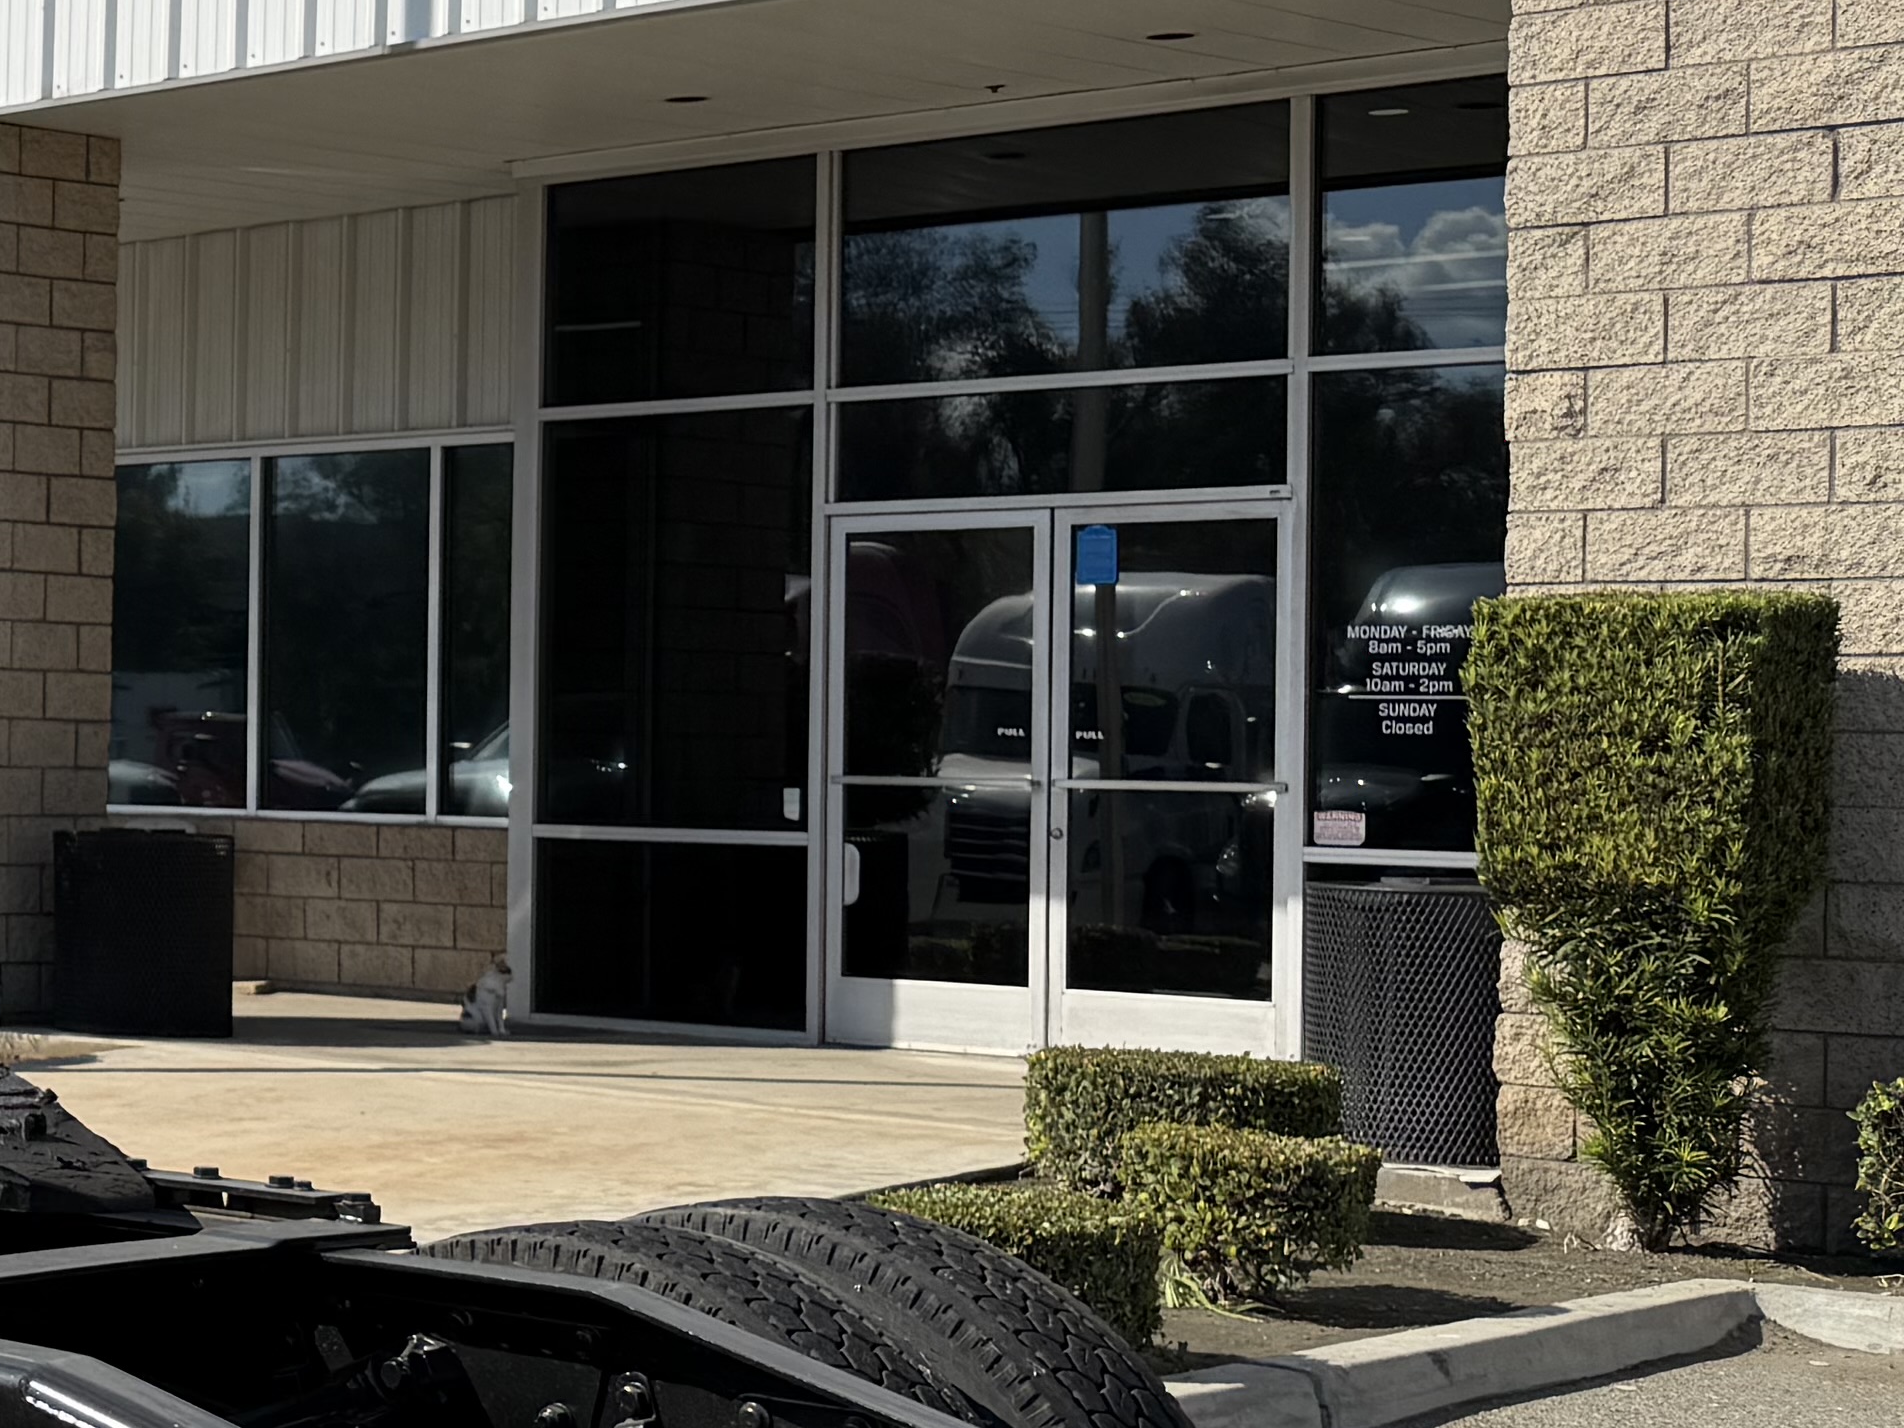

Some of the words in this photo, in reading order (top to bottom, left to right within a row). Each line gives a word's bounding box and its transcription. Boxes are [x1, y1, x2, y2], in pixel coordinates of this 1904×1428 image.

[1347, 625, 1408, 639] MONDAY
[1368, 640, 1402, 654] 8am
[1417, 640, 1451, 656] 5pm
[1372, 662, 1446, 676] SATURDAY
[1366, 678, 1405, 693] 10am
[1419, 678, 1453, 694] 2pm
[1379, 703, 1437, 717] SUNDAY
[1382, 720, 1433, 735] Closed
[1075, 730, 1104, 740] PULL
